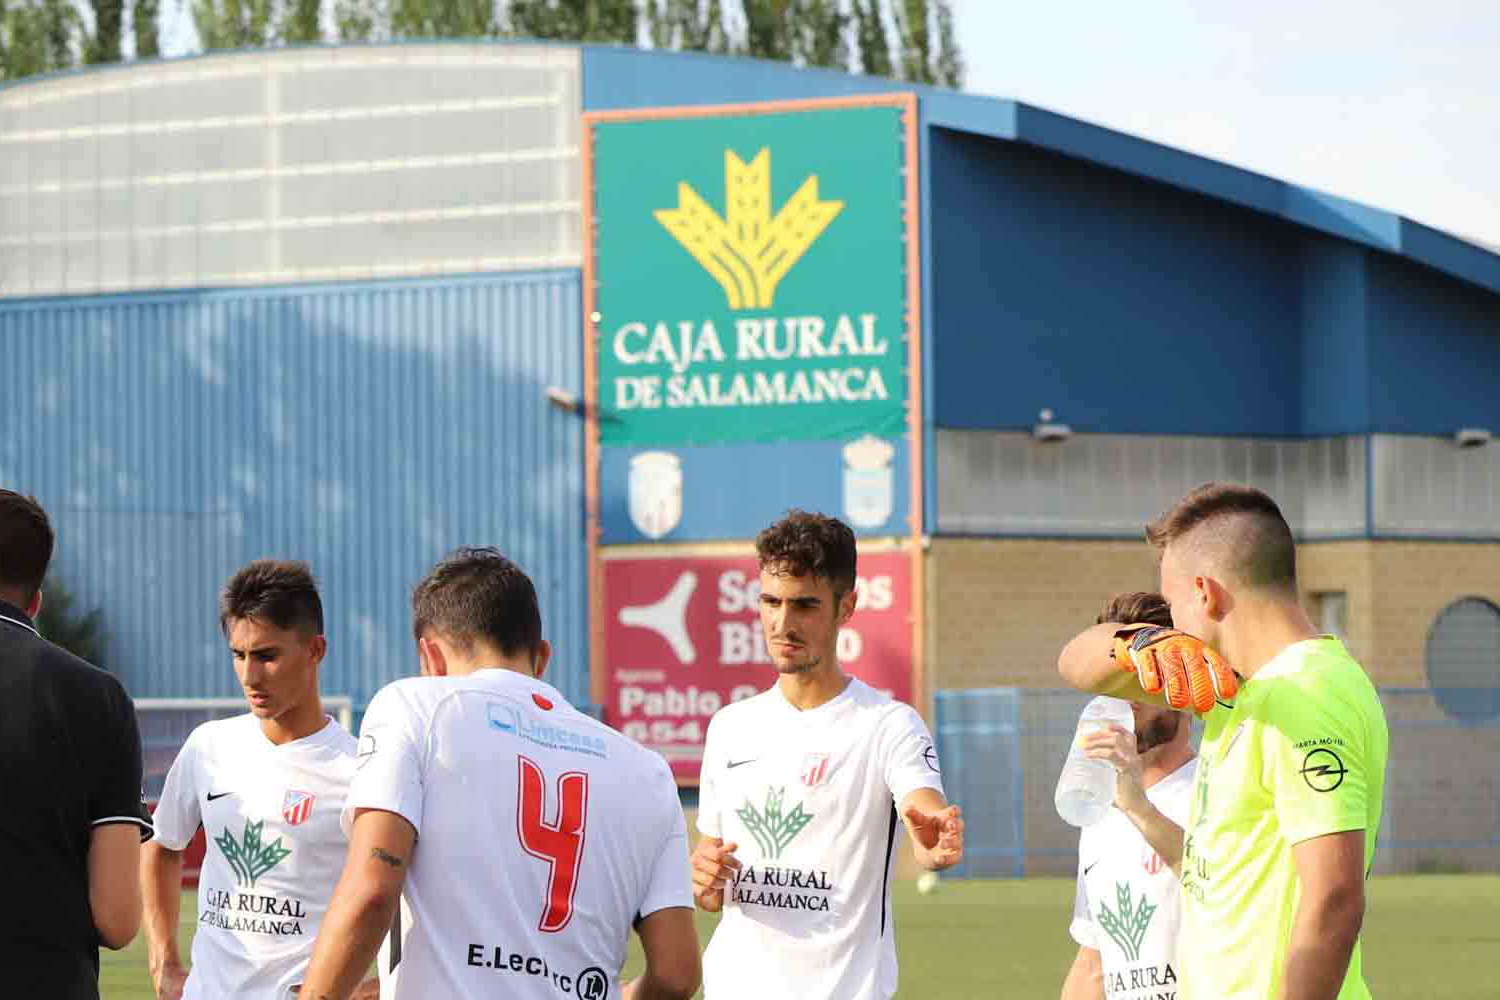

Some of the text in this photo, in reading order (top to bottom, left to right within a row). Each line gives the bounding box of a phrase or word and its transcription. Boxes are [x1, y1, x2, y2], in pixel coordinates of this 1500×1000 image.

[613, 314, 889, 373] CAJA RURAL
[614, 367, 889, 410] DE SALAMANCA
[620, 686, 721, 717] Pablo
[517, 753, 589, 934] 4
[763, 867, 832, 890] RURAL
[238, 893, 306, 918] RURAL
